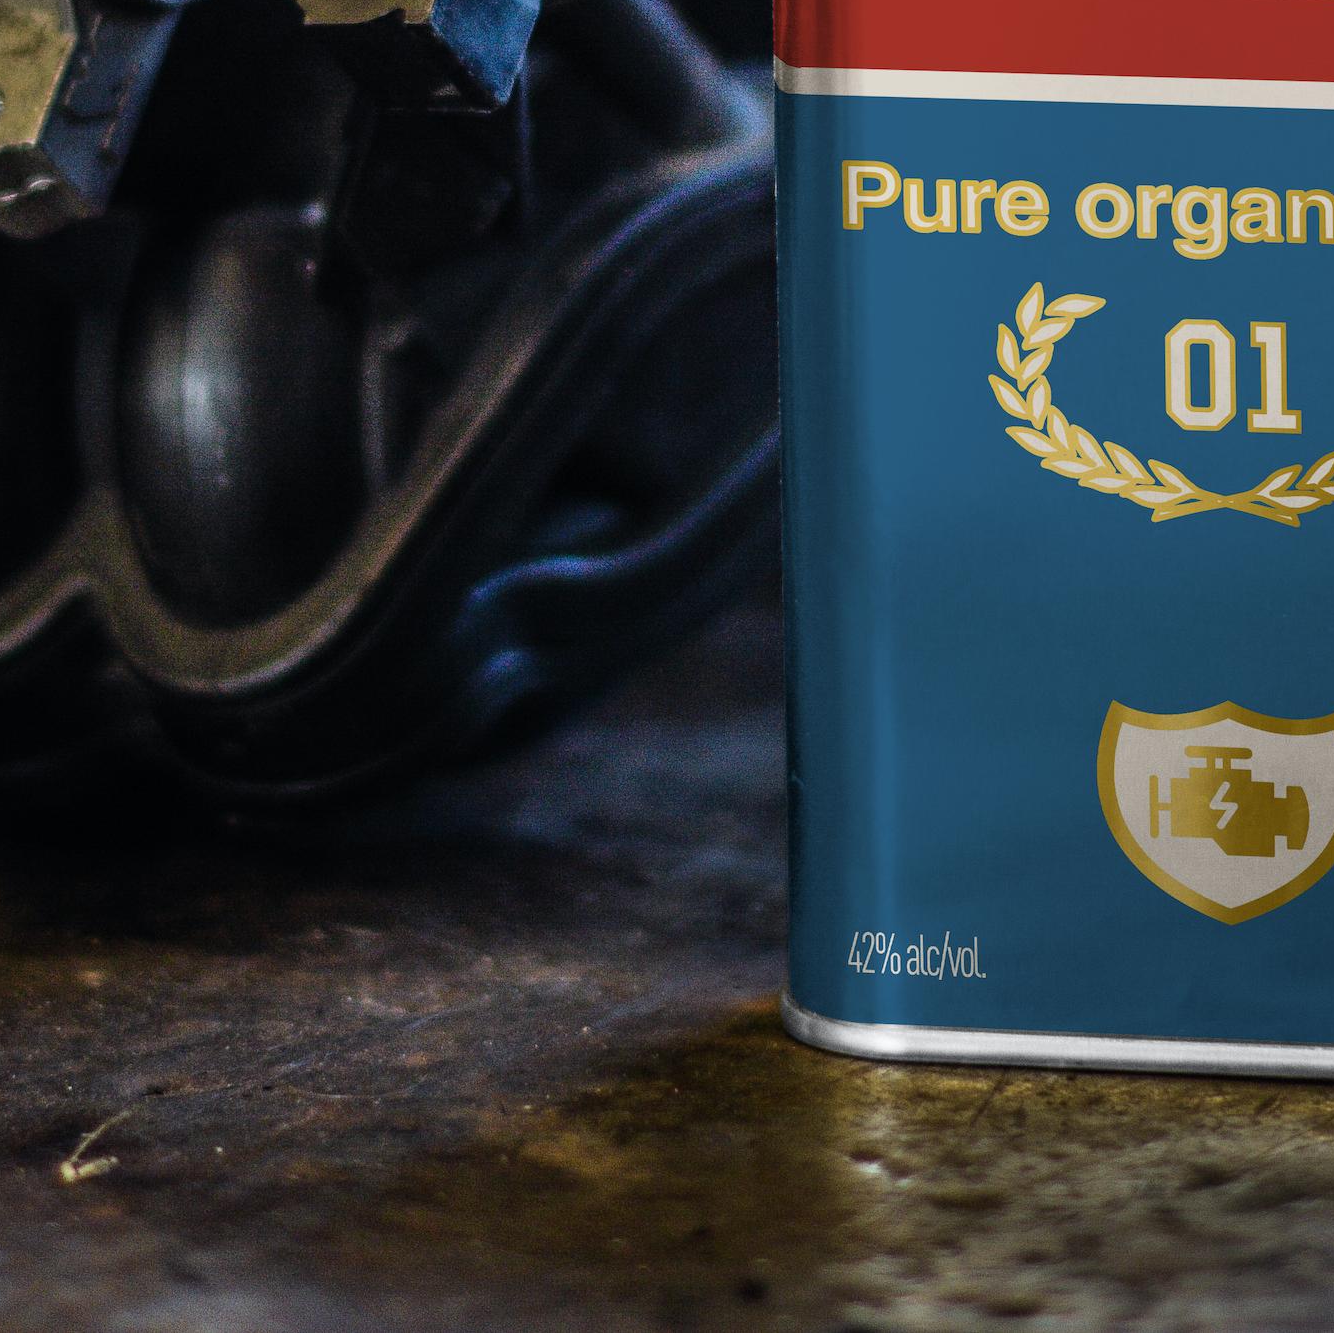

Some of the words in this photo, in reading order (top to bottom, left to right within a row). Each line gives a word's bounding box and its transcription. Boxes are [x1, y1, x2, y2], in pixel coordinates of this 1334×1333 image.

[841, 159, 1051, 236] Pure
[1164, 318, 1303, 435] 01
[847, 931, 903, 975] 42%
[906, 930, 988, 981] alc/vol.
